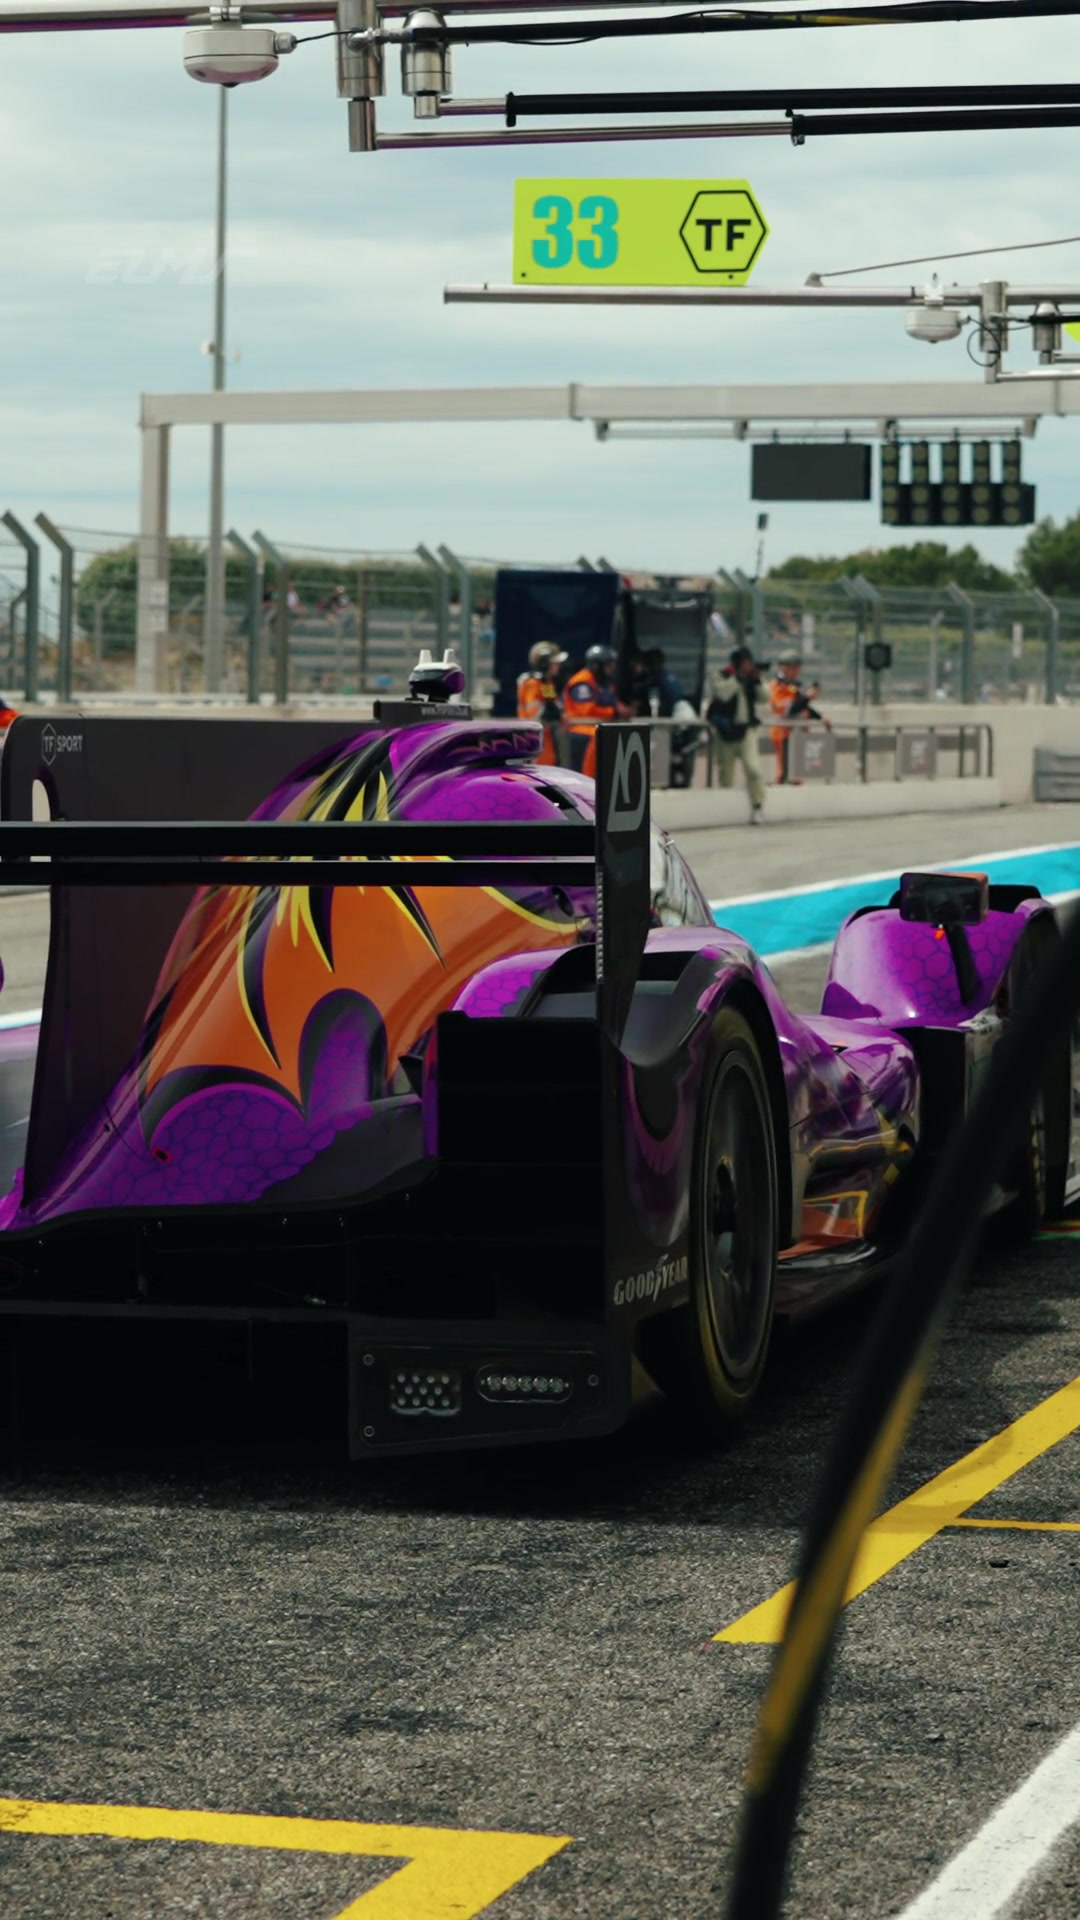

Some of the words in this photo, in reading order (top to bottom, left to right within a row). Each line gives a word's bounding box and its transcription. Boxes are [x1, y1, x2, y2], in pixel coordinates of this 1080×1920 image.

[531, 194, 619, 269] 33
[695, 218, 752, 251] TF
[44, 735, 55, 753] TF
[56, 735, 83, 752] SPORT
[613, 1253, 688, 1306] GOODYEAR
